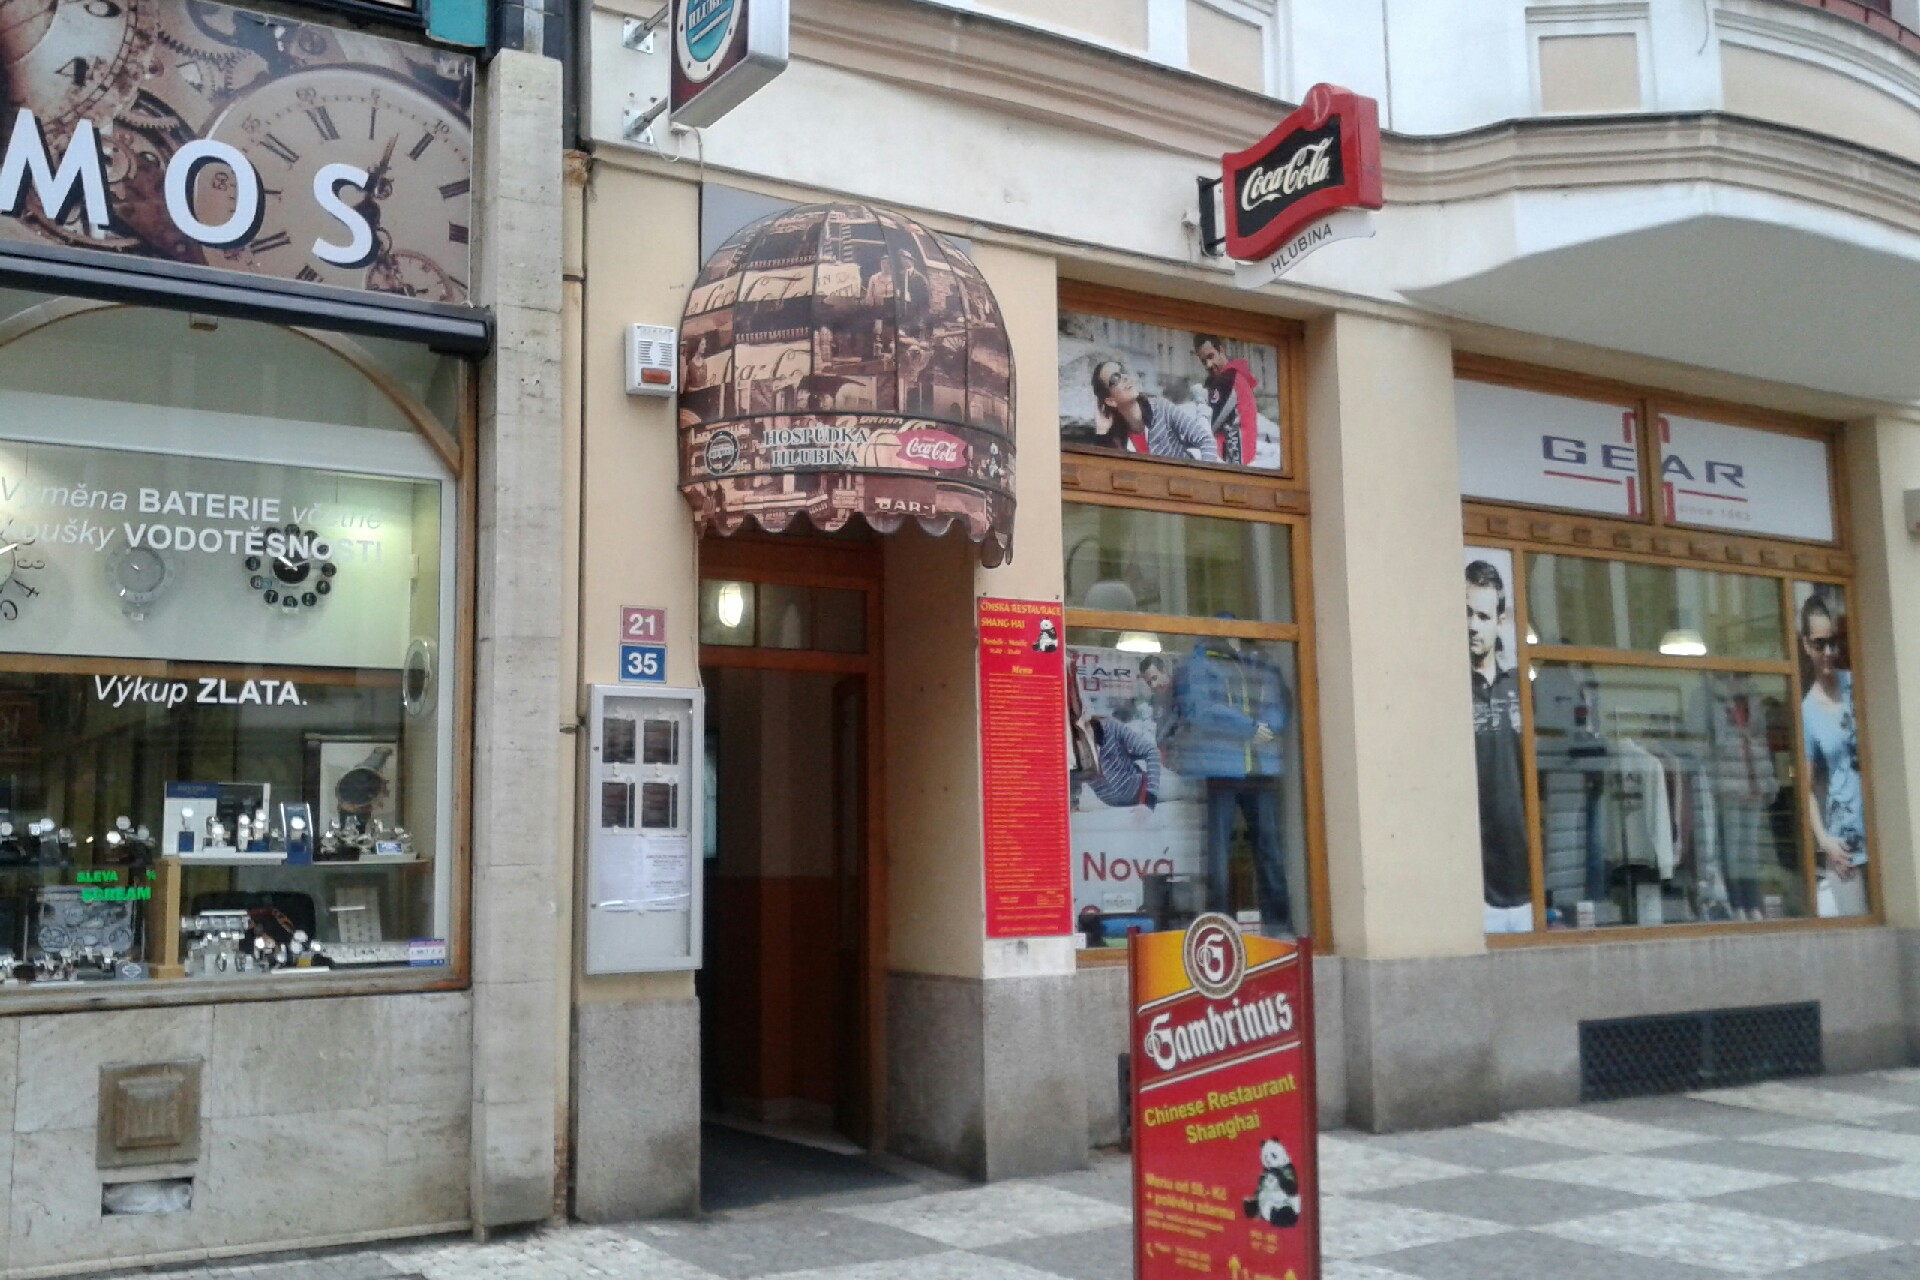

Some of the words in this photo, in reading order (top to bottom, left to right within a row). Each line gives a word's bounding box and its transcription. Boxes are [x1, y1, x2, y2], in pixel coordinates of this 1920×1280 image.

[1241, 137, 1334, 211] Coca-Cola
[1270, 223, 1333, 274] HLUBINA
[771, 447, 858, 468] HLUBINA
[906, 437, 958, 462] Coca-Cola
[1542, 434, 1746, 489] GEAR
[139, 487, 281, 523] BATERIE
[629, 614, 656, 635] 21
[628, 652, 658, 674] 35
[94, 675, 188, 709] Výkup
[197, 677, 308, 706] ZLATA.
[1145, 992, 1293, 1071] Gambrinus
[1145, 1096, 1205, 1127] Chinese
[1207, 1073, 1297, 1111] Restaurant
[1186, 1110, 1260, 1144] Shanghai
